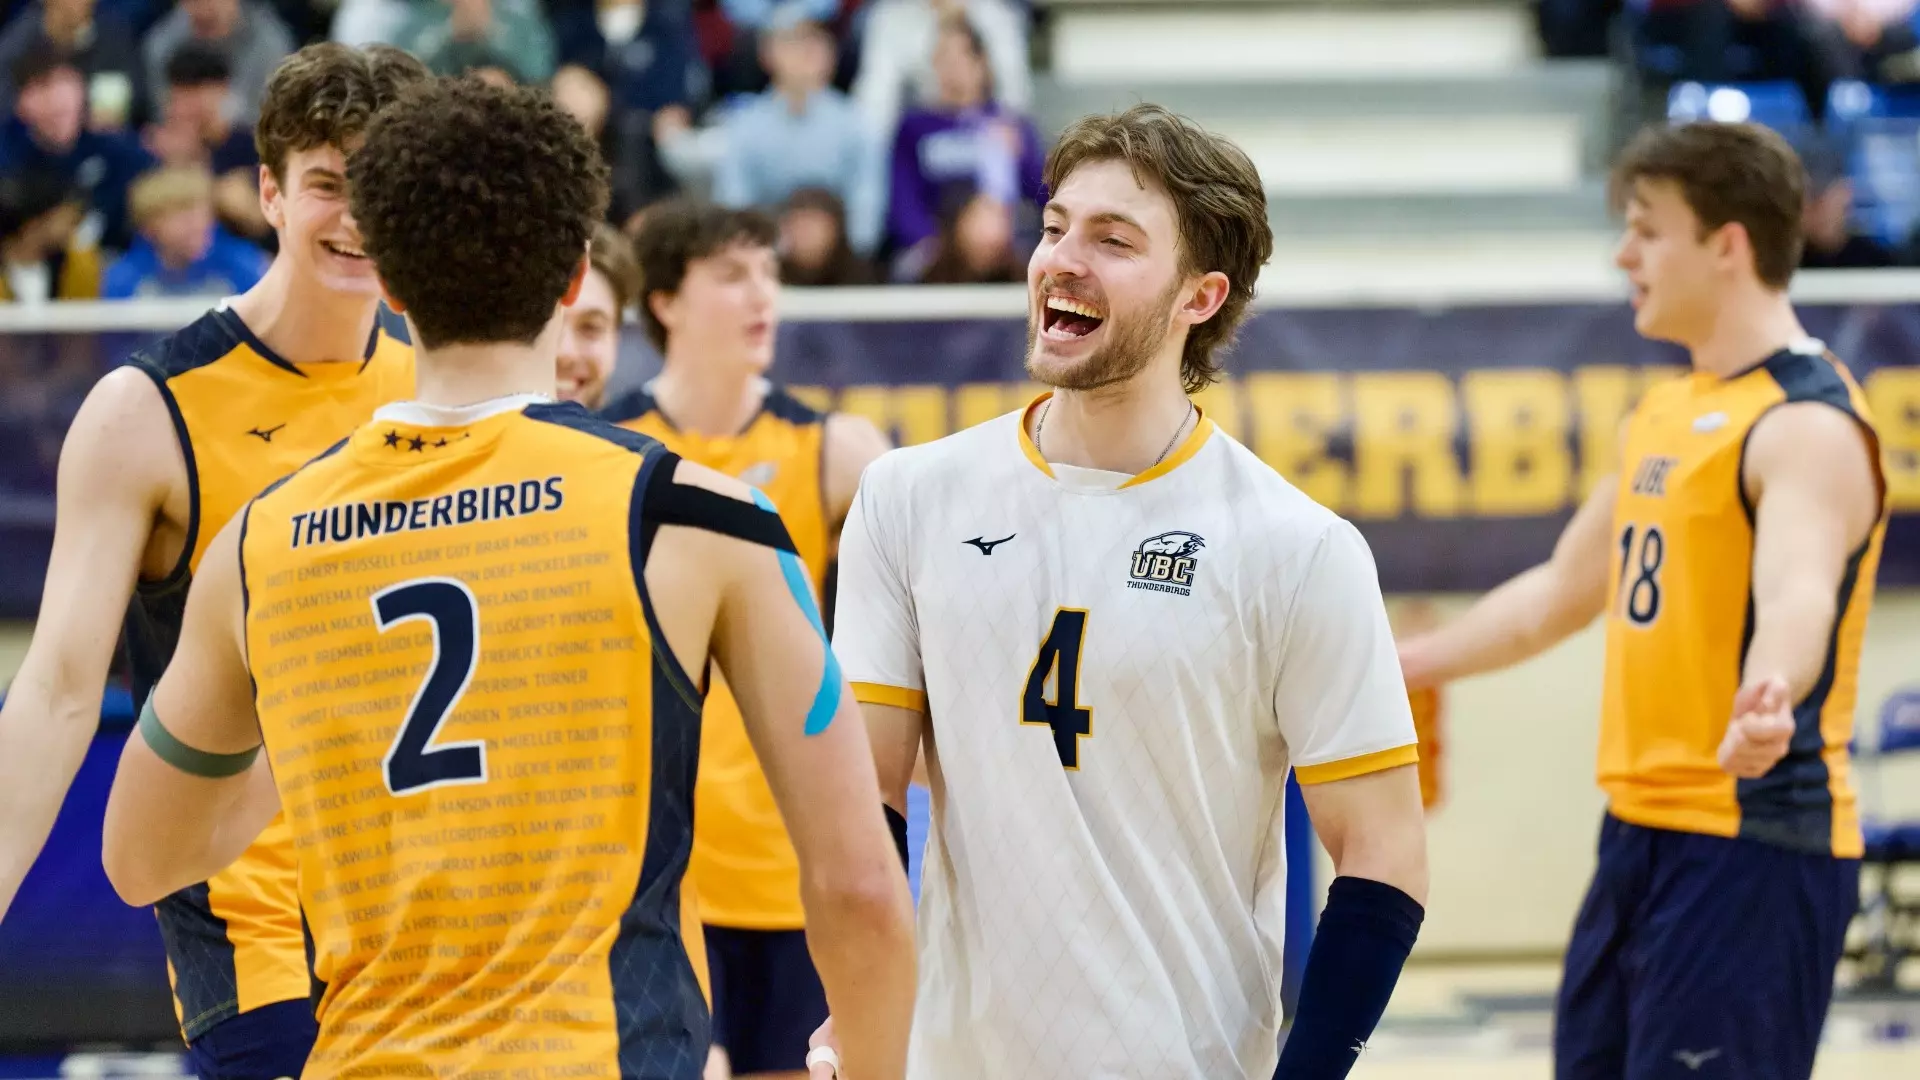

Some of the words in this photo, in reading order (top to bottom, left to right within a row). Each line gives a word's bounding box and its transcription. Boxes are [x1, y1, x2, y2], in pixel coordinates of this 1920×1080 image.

[290, 476, 564, 549] THUNDERBIRDS
[297, 562, 338, 582] EMERY
[343, 553, 395, 574] RUSSELL
[401, 546, 441, 566] CLARK
[1130, 551, 1197, 586] UBC
[1611, 523, 1664, 627] 18
[532, 580, 592, 601] BENNETT
[1127, 580, 1191, 597] THUNDERBIRDS
[316, 639, 373, 666] BREMNER
[371, 577, 487, 795] 2
[533, 667, 588, 687] TURNER
[1019, 608, 1092, 769] 4
[502, 730, 562, 748] MUELLER
